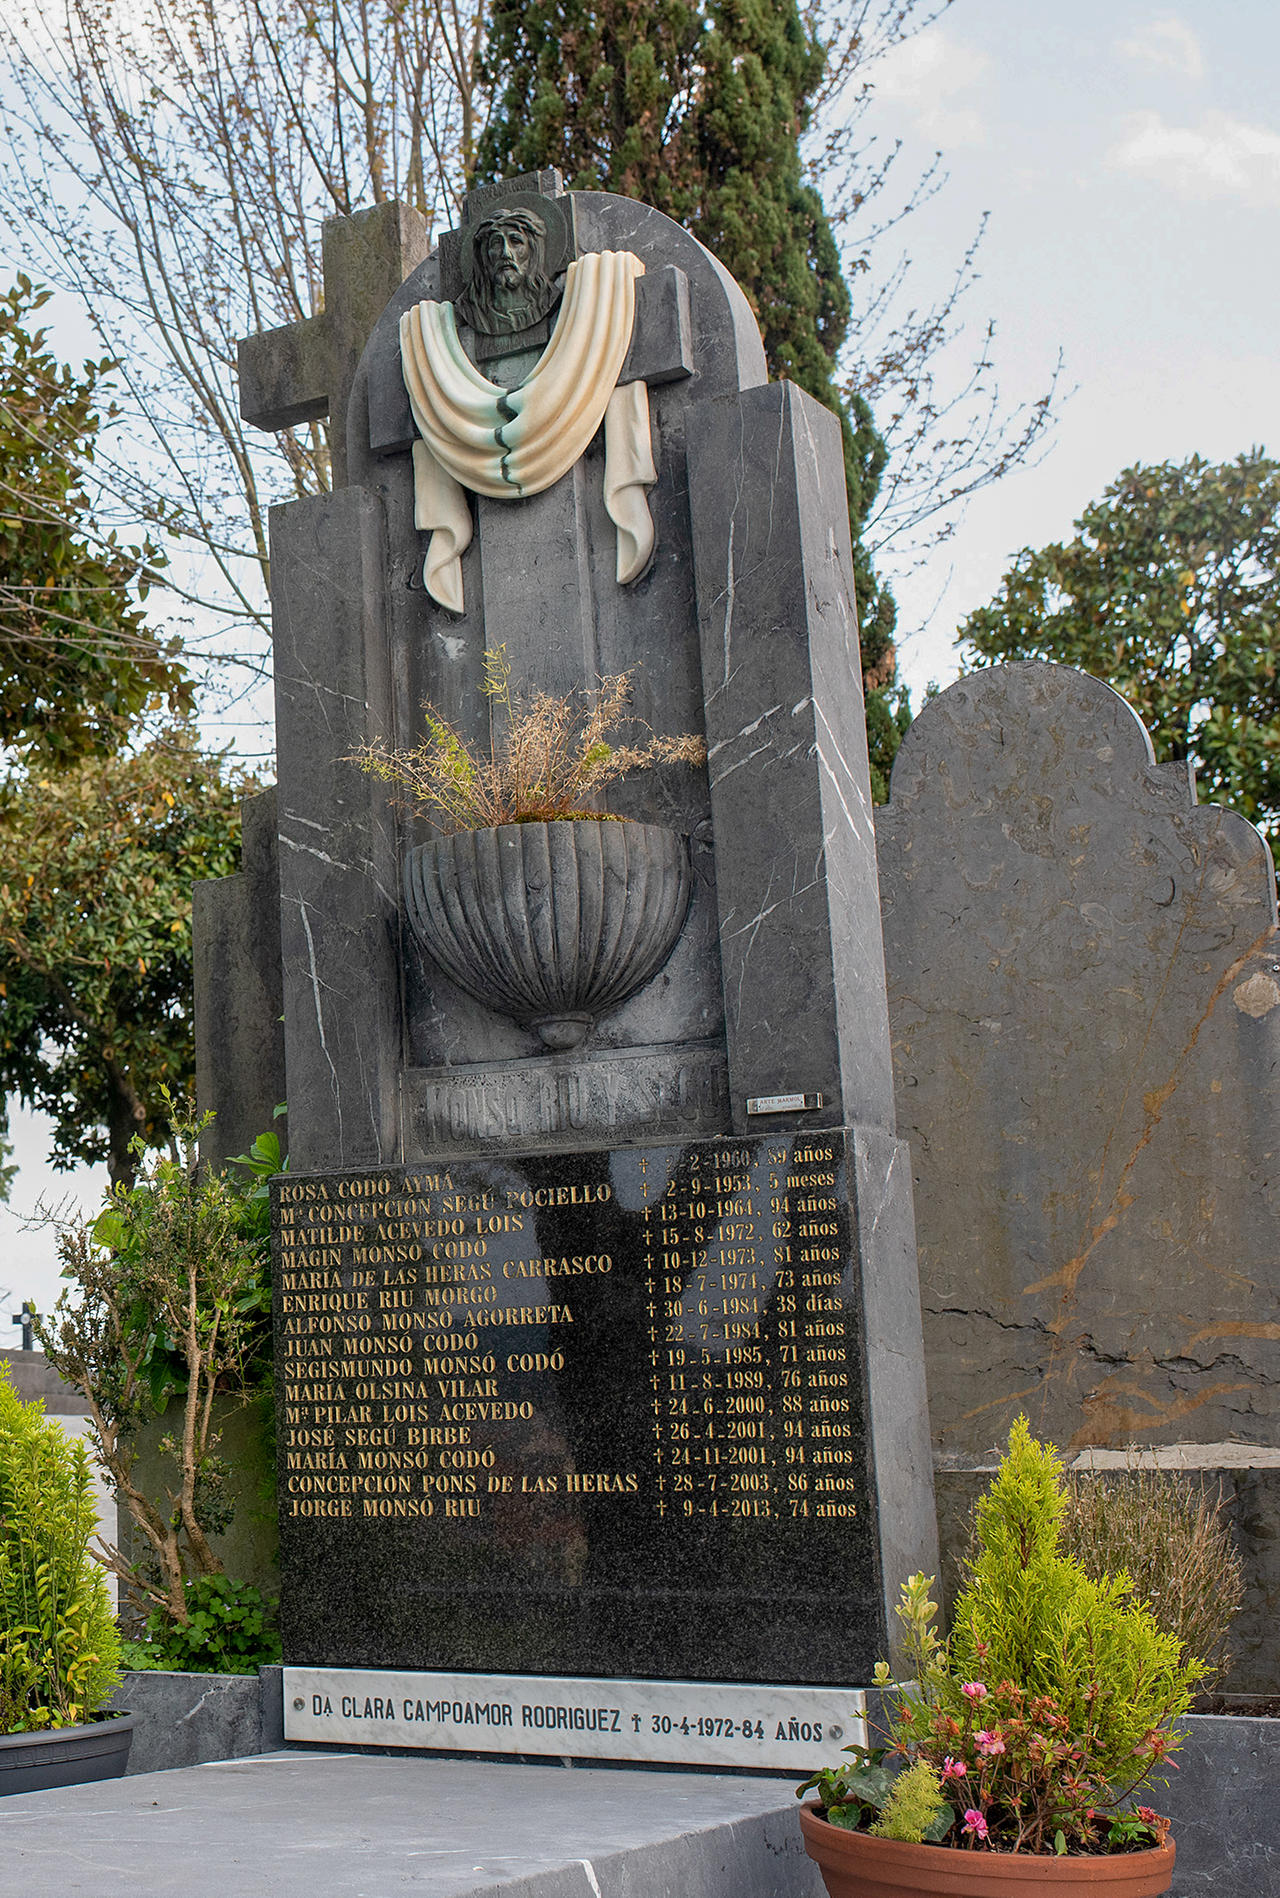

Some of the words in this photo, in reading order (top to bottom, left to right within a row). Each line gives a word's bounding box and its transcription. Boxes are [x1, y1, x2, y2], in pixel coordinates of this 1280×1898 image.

[280, 1183, 328, 1203] ROSA
[339, 1178, 390, 1197] CODÓ
[794, 1145, 833, 1162] años
[309, 1196, 431, 1222] CONCEPCIÓN
[443, 1189, 494, 1214] SEGÚ
[507, 1184, 612, 1208] POCIELLO
[769, 1173, 778, 1189] 5
[787, 1172, 834, 1188] meses
[281, 1225, 363, 1247] MATILDE
[376, 1218, 464, 1241] ACEVEDO
[478, 1214, 523, 1233] LOIS
[771, 1197, 790, 1214] 94
[798, 1194, 836, 1212] años
[433, 1236, 486, 1258] CODÓ
[772, 1221, 791, 1238] 62
[798, 1219, 838, 1236] años
[282, 1268, 342, 1290] MARÍA
[353, 1272, 375, 1286] DE
[384, 1268, 416, 1285] LAS
[426, 1263, 491, 1283] HERAS
[503, 1254, 612, 1278] CARRASCO
[774, 1246, 791, 1263] 81
[800, 1243, 839, 1261] años
[283, 1292, 368, 1312] ENRIQUE
[380, 1291, 413, 1308] RIU
[425, 1285, 497, 1306] MORGO
[776, 1270, 794, 1287] 73
[802, 1268, 841, 1286] años
[285, 1315, 371, 1335] ALFONSO
[383, 1307, 453, 1330] MONSÓ
[464, 1304, 573, 1326] AGORRETA
[776, 1295, 796, 1312] 38
[806, 1293, 843, 1311] días
[285, 1339, 332, 1357] JUAN
[344, 1334, 412, 1353] MONSÓ
[424, 1332, 478, 1351] CODÓ
[778, 1320, 797, 1338] 81
[805, 1318, 844, 1336] años
[285, 1359, 412, 1378] SEGISMUNDO
[424, 1352, 495, 1375] MONSÓ
[507, 1348, 564, 1372] CODÓ
[780, 1345, 797, 1362] 71
[806, 1343, 846, 1361] años
[285, 1378, 345, 1401] MARÍA
[356, 1381, 429, 1400] OLSINA
[440, 1379, 498, 1397] VILAR
[781, 1371, 800, 1387] 76
[808, 1369, 848, 1386] años
[315, 1405, 372, 1423] PILAR
[383, 1405, 428, 1422] LOIS
[440, 1402, 533, 1420] ACEVEDO
[783, 1396, 802, 1412] 88
[810, 1394, 849, 1412] años
[287, 1425, 334, 1446] JOSÉ
[345, 1423, 396, 1445] SEGÚ
[408, 1427, 470, 1445] BIRBE
[784, 1421, 803, 1438] 94
[811, 1419, 851, 1438] años
[287, 1448, 348, 1469] MARÍA
[358, 1448, 429, 1468] MONSÓ
[440, 1445, 495, 1468] CODÓ
[785, 1446, 805, 1464] 94
[813, 1445, 852, 1463] años
[288, 1472, 411, 1492] CONCEPCIÓN
[423, 1475, 476, 1492] PONS
[488, 1476, 512, 1492] DE
[522, 1476, 557, 1492] LAS
[566, 1474, 638, 1492] HERAS
[788, 1474, 807, 1490] 86
[815, 1472, 854, 1490] años
[289, 1499, 352, 1517] JORGE
[363, 1495, 433, 1516] MONSÓ
[446, 1499, 480, 1516] RIU
[790, 1500, 809, 1516] 74
[817, 1498, 856, 1516] años
[342, 1696, 395, 1719] CLARA
[404, 1699, 512, 1726] CAMPOAMOR
[522, 1705, 621, 1732] RODRIGUEZ
[775, 1716, 823, 1742] AÑOS
